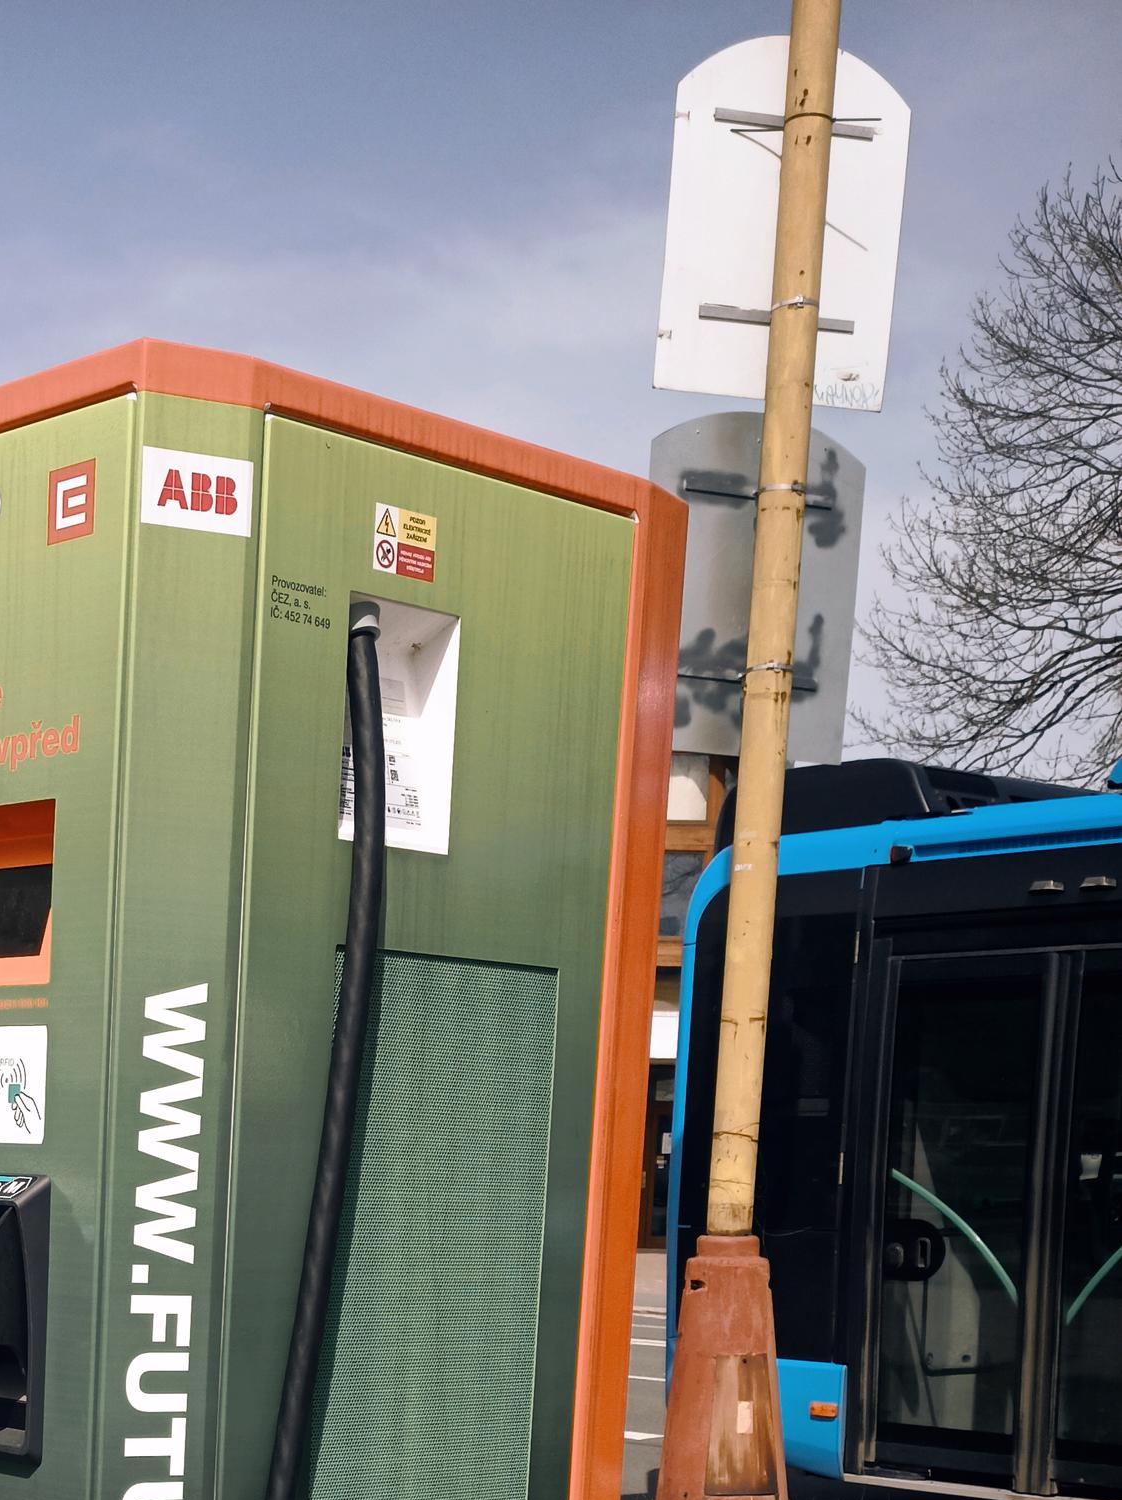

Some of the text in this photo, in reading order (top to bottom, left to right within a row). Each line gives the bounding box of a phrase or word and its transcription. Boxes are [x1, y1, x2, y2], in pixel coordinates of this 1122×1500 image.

[157, 468, 238, 516] ABB
[271, 575, 327, 597] Provozovatel:
[271, 588, 310, 610] ČEZ, a. s.
[284, 610, 301, 623] 452
[302, 613, 312, 625] 74
[314, 616, 331, 629] 649
[3, 1181, 25, 1194] M
